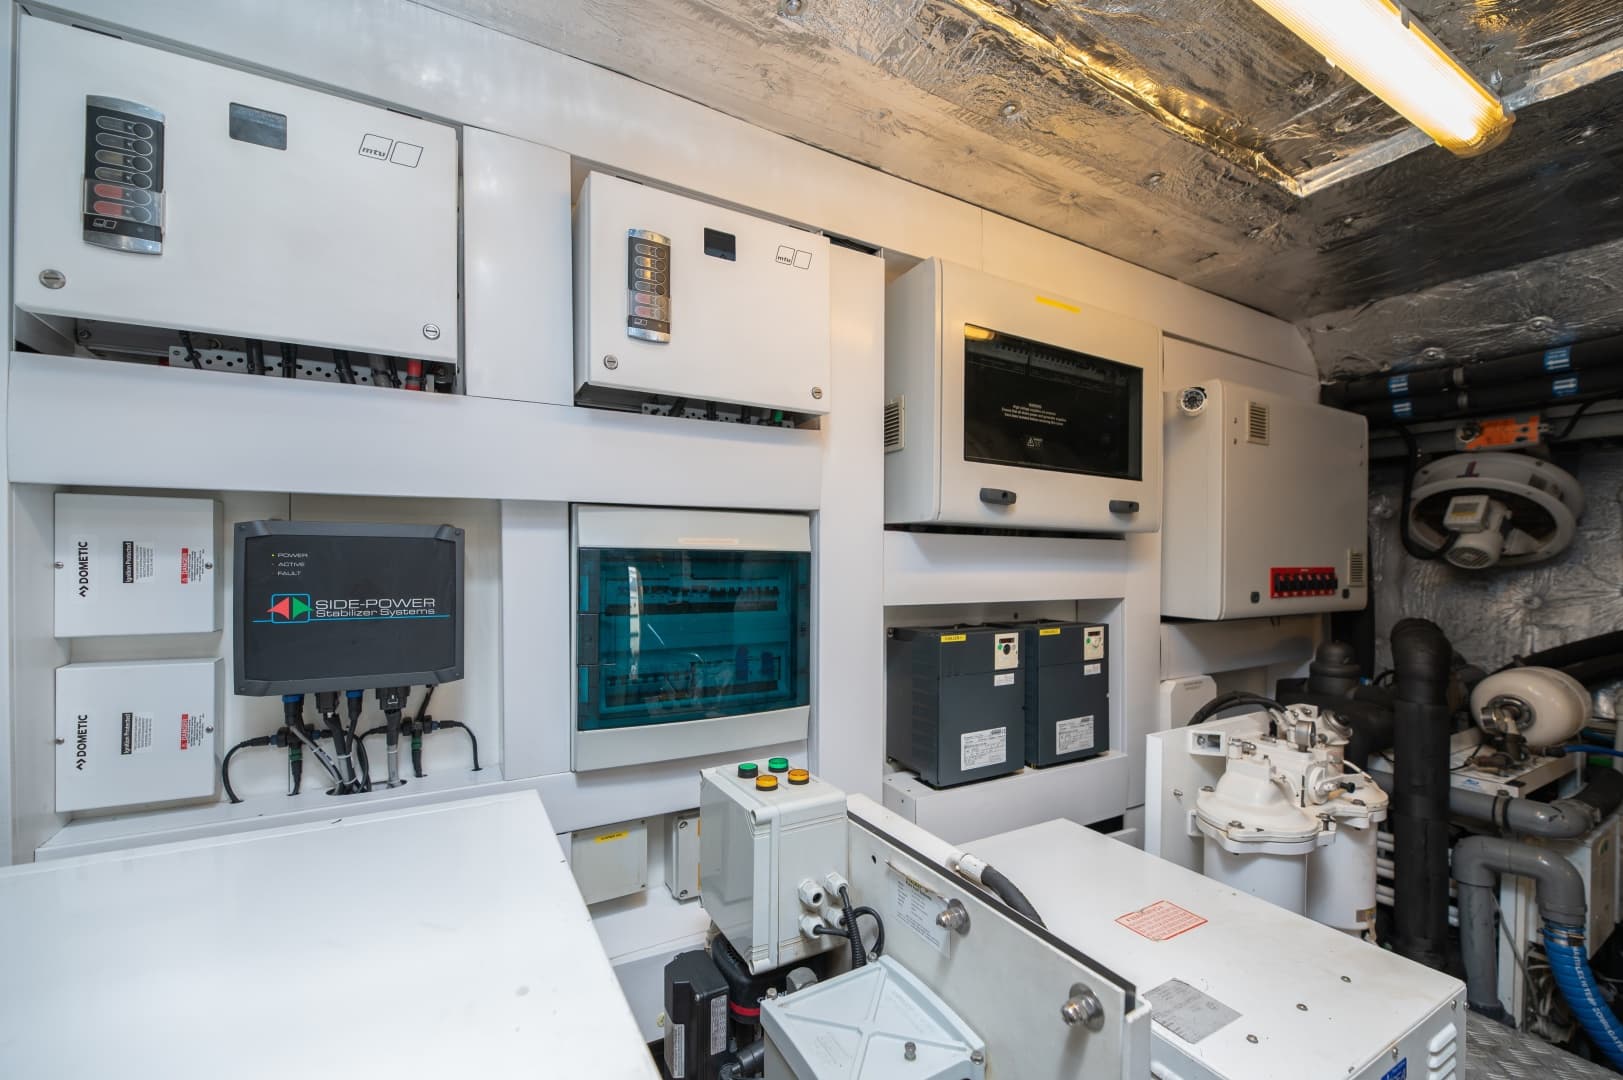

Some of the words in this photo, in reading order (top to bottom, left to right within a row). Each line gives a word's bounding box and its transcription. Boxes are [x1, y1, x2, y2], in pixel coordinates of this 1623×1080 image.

[362, 147, 386, 157] mtu
[78, 541, 88, 584] DOMETIC
[315, 598, 435, 610] SIDE-POWER
[316, 609, 378, 618] Stabilizer
[380, 608, 435, 618] Systems
[76, 714, 88, 757] DOMETIC
